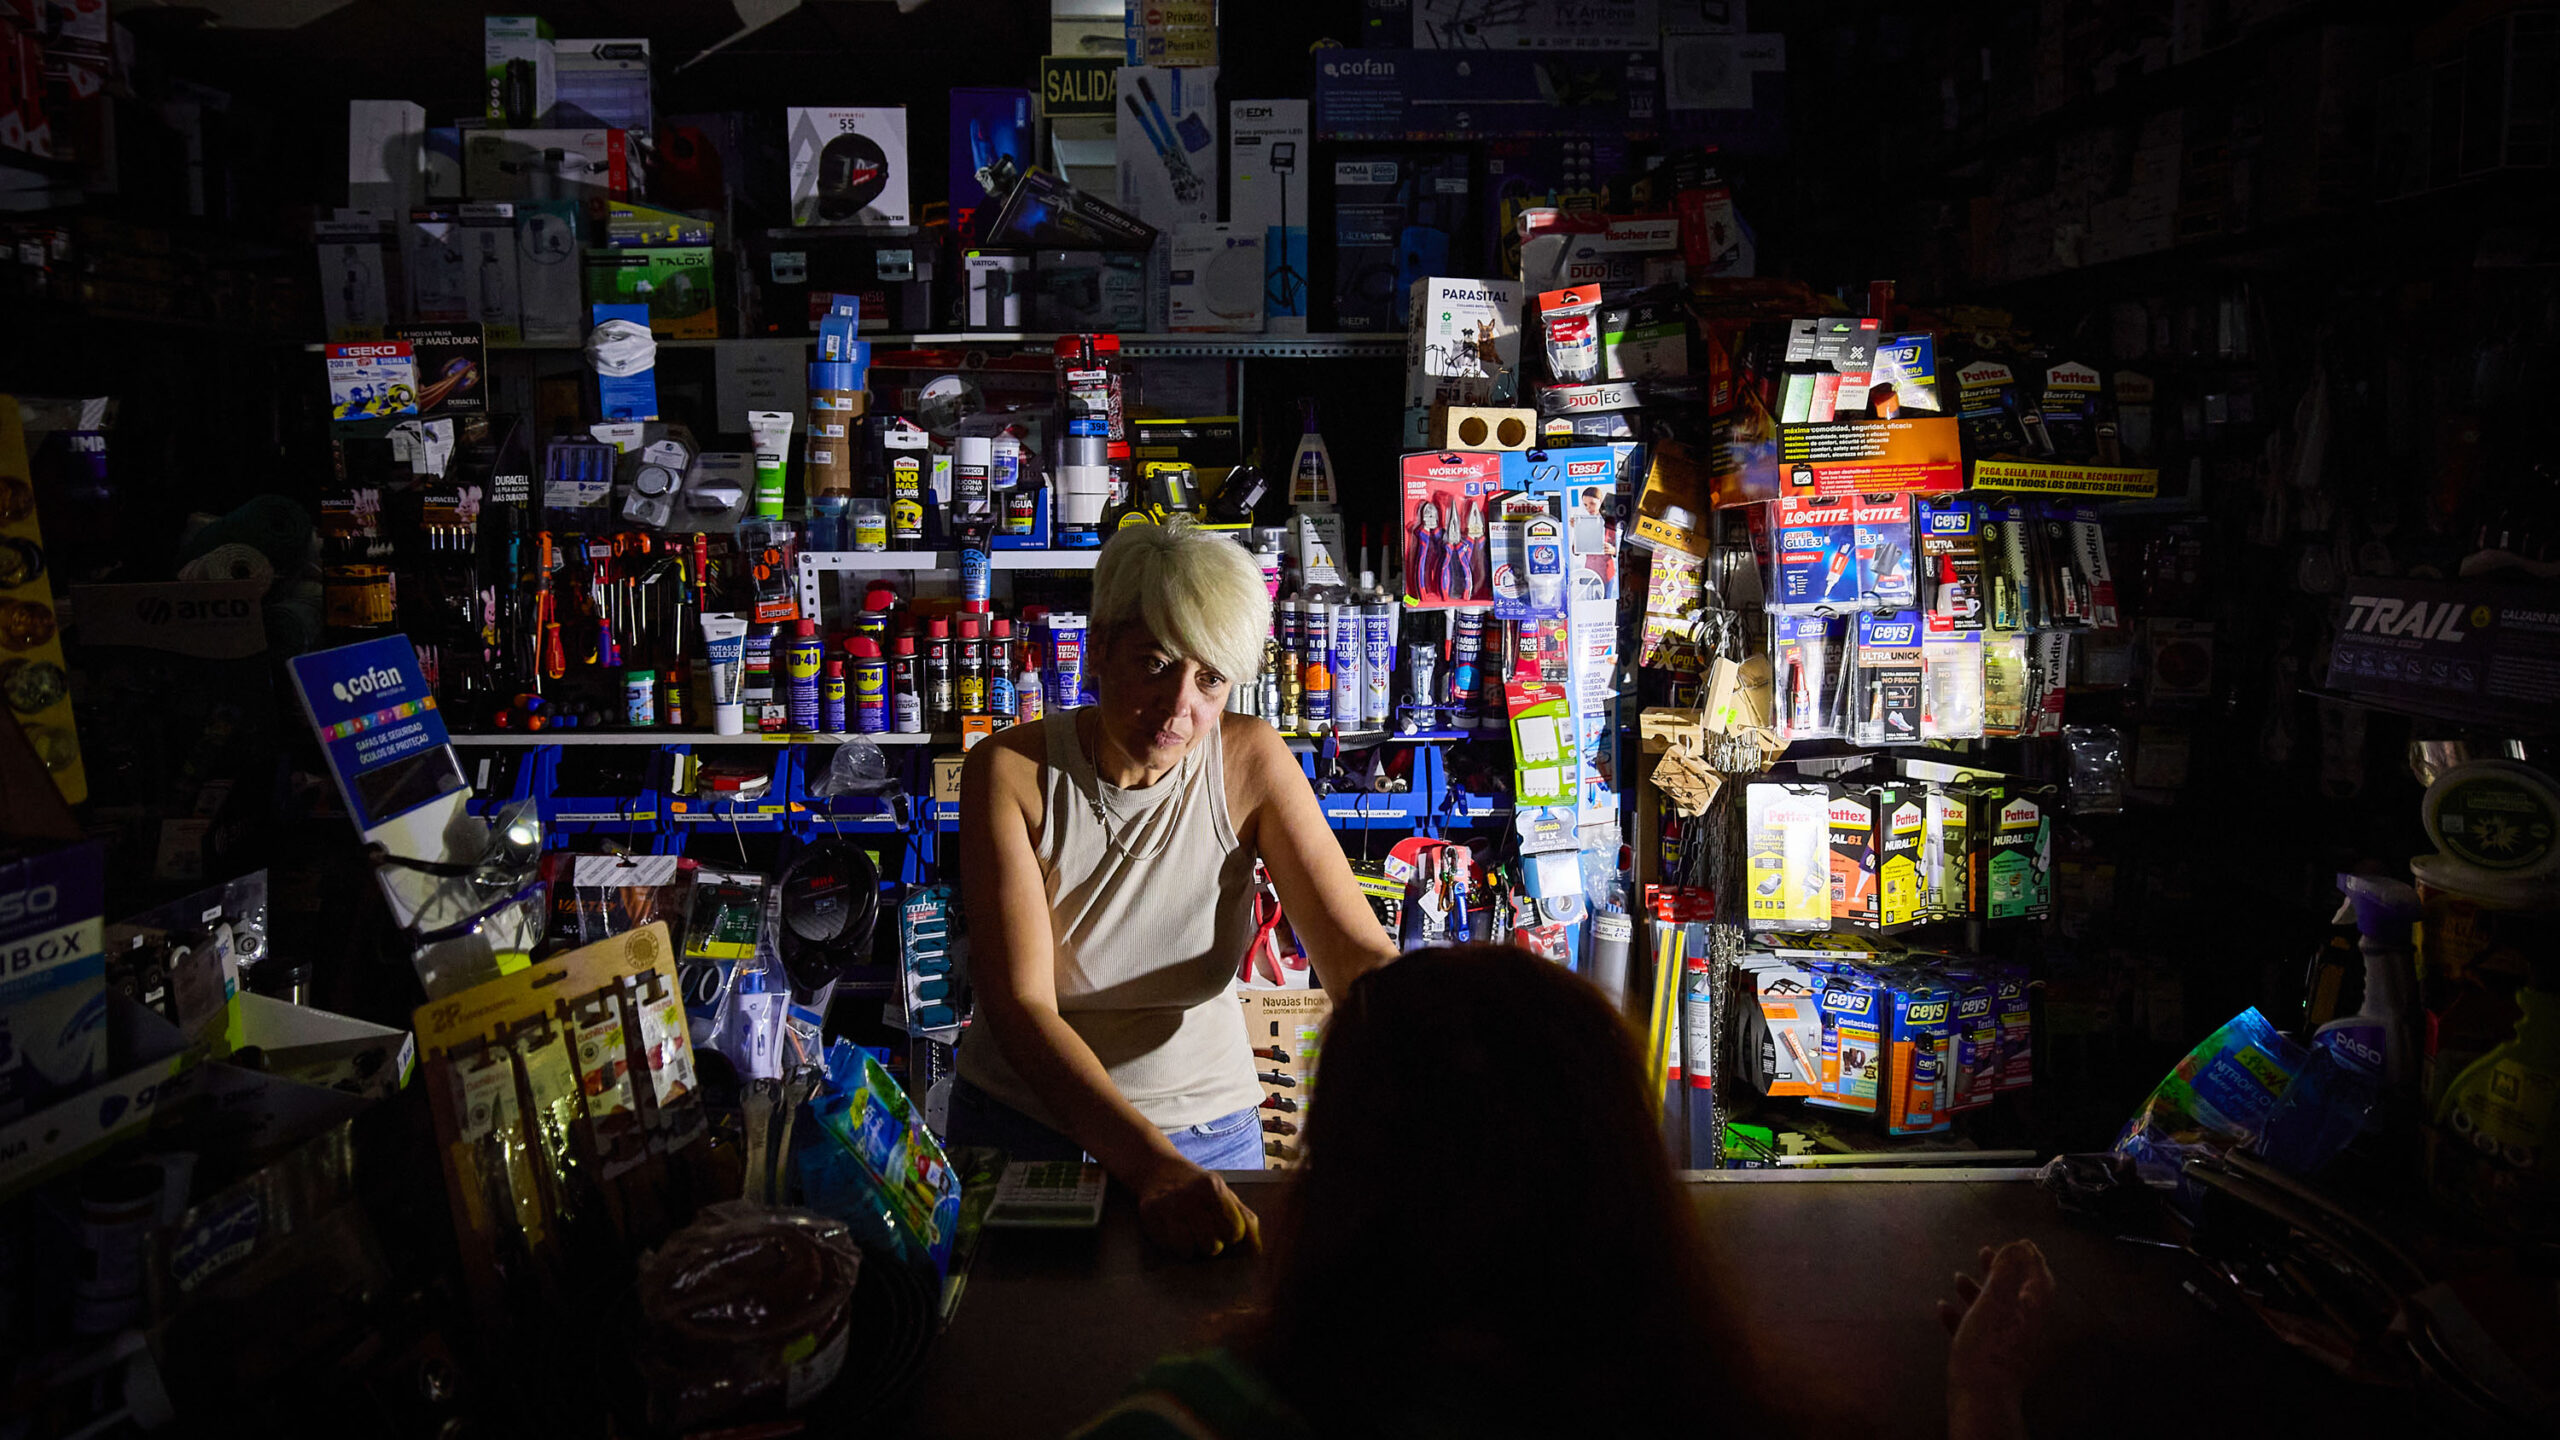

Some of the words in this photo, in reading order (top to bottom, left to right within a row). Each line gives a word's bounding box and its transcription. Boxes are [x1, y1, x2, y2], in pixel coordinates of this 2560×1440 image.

[1166, 10, 1208, 23] Privado
[1557, 6, 1576, 19] TV
[1580, 5, 1635, 20] Antena
[1339, 58, 1395, 75] cofan
[1047, 69, 1117, 103] SALIDA
[1246, 108, 1273, 117] EDM
[839, 119, 855, 129] 55
[1604, 228, 1649, 241] fischer
[656, 257, 706, 266] TALOX
[1442, 288, 1509, 303] PARASITAL
[426, 337, 450, 346] MAIS
[347, 345, 398, 357] GEKO
[1962, 368, 2007, 382] Pattex
[2052, 371, 2096, 383] Pattex
[1959, 387, 2001, 399] Barrita
[2042, 390, 2086, 399] Barrita
[447, 398, 481, 406] DURACELL
[1089, 422, 1106, 431] 398
[1547, 423, 1571, 432] Pattex
[1811, 425, 1850, 434] comodidad,
[1851, 423, 1886, 432] seguridad,
[1428, 467, 1476, 476] WORKPRO
[1571, 462, 1598, 475] tesa
[494, 475, 530, 485] DURACELL
[895, 471, 919, 483] NO
[1978, 477, 2014, 487] REPARA
[2015, 479, 2046, 489] TODOS
[2047, 480, 2063, 490] LOS
[2065, 481, 2104, 491] OBJETOS
[2106, 483, 2121, 492] DEL
[2122, 484, 2155, 494] HOGAR
[895, 489, 920, 498] CLAVOS
[1009, 500, 1033, 508] AGUA
[1506, 502, 1545, 514] Pattex
[1784, 508, 1850, 525] LOCTITE
[1853, 507, 1904, 522] OCTITE
[1933, 513, 1966, 529] ceys
[2086, 523, 2102, 578] Araldite
[177, 600, 249, 619] arco
[759, 606, 794, 618] claber
[2344, 595, 2466, 643] TRAIL
[1367, 620, 1388, 631] ceys
[1800, 622, 1824, 634] ceys
[1058, 631, 1078, 640] ceys
[1874, 624, 1909, 640] ceys
[1057, 644, 1080, 652] TOTAL
[1336, 641, 1359, 651] STOP
[1366, 641, 1388, 651] STOP
[789, 653, 817, 666] WD-40
[1057, 651, 1079, 659] TECH
[2048, 633, 2063, 686] Araldite
[347, 664, 404, 696] cofan
[857, 671, 880, 681] WD-40
[355, 736, 379, 752] GAFAS
[387, 721, 423, 741] SEGURIDAD
[1895, 813, 1920, 827] Pattex
[2004, 809, 2035, 822] Pattex
[1534, 822, 1561, 833] Scotch
[1538, 832, 1558, 840] FIX
[906, 903, 939, 913] TOTAL
[1262, 996, 1301, 1008] Navajas
[1827, 992, 1866, 1009] ceys
[1961, 998, 1988, 1013] ceys
[2008, 1001, 2028, 1012] Textil
[1910, 1003, 1945, 1020] ceys
[1838, 1016, 1879, 1031] Contactceys
[1977, 1018, 1995, 1030] Textil
[2335, 1031, 2382, 1065] PASO
